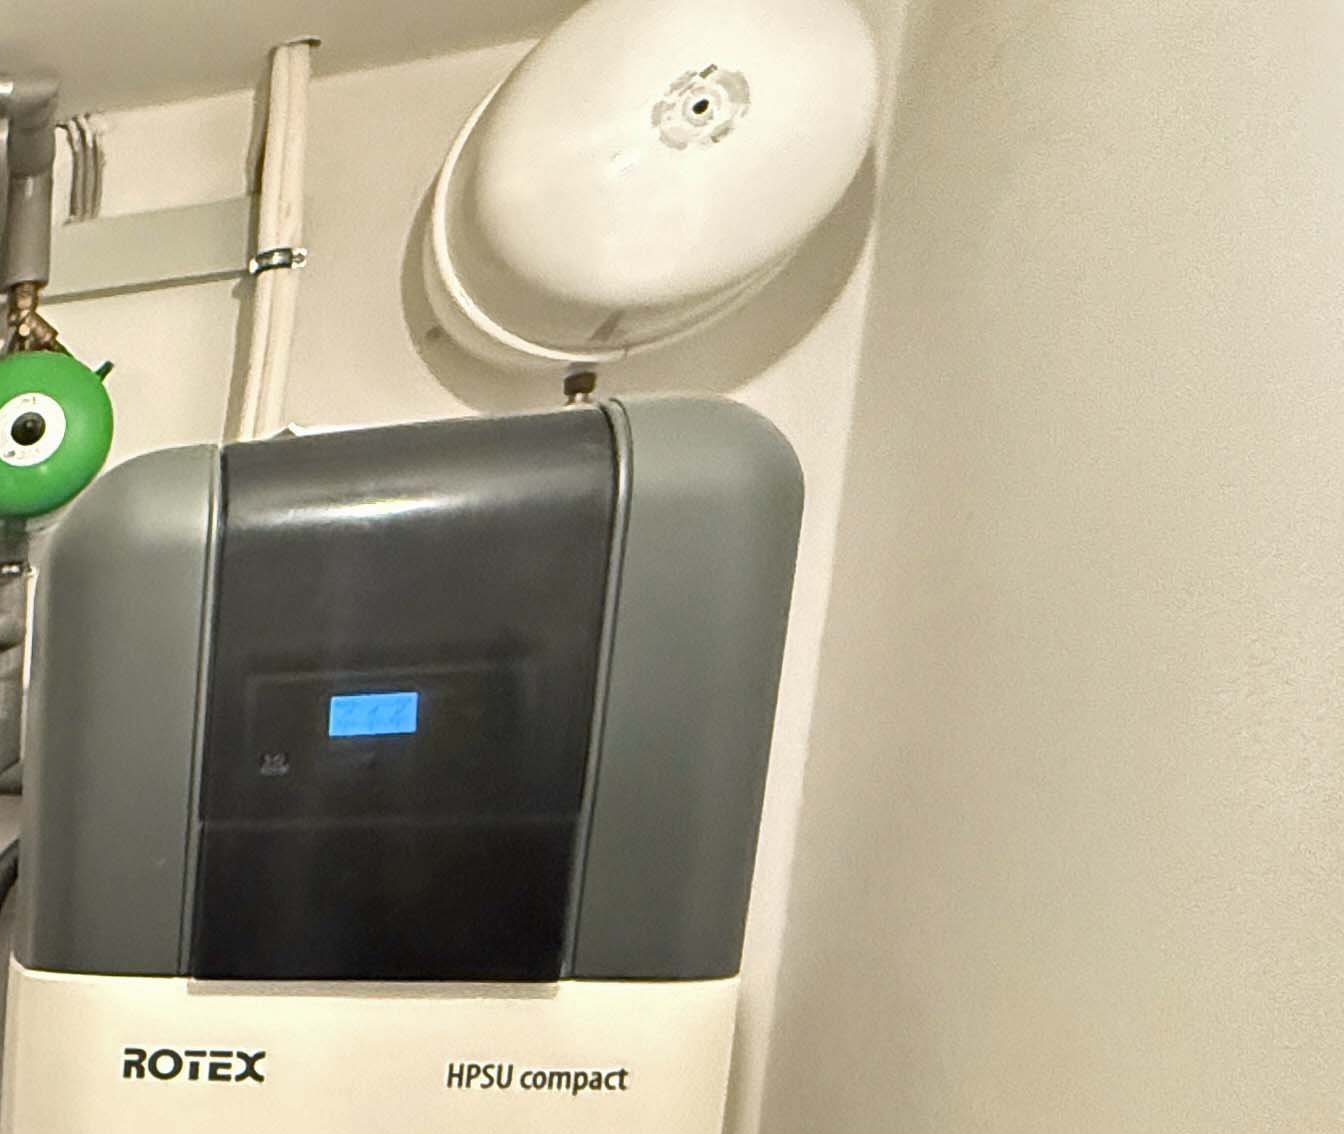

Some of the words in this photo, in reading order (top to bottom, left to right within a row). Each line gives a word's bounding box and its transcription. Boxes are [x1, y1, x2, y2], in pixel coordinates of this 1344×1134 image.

[123, 1048, 266, 1083] ROTEX
[446, 1063, 514, 1089] HPSU
[520, 1068, 629, 1096] compact
